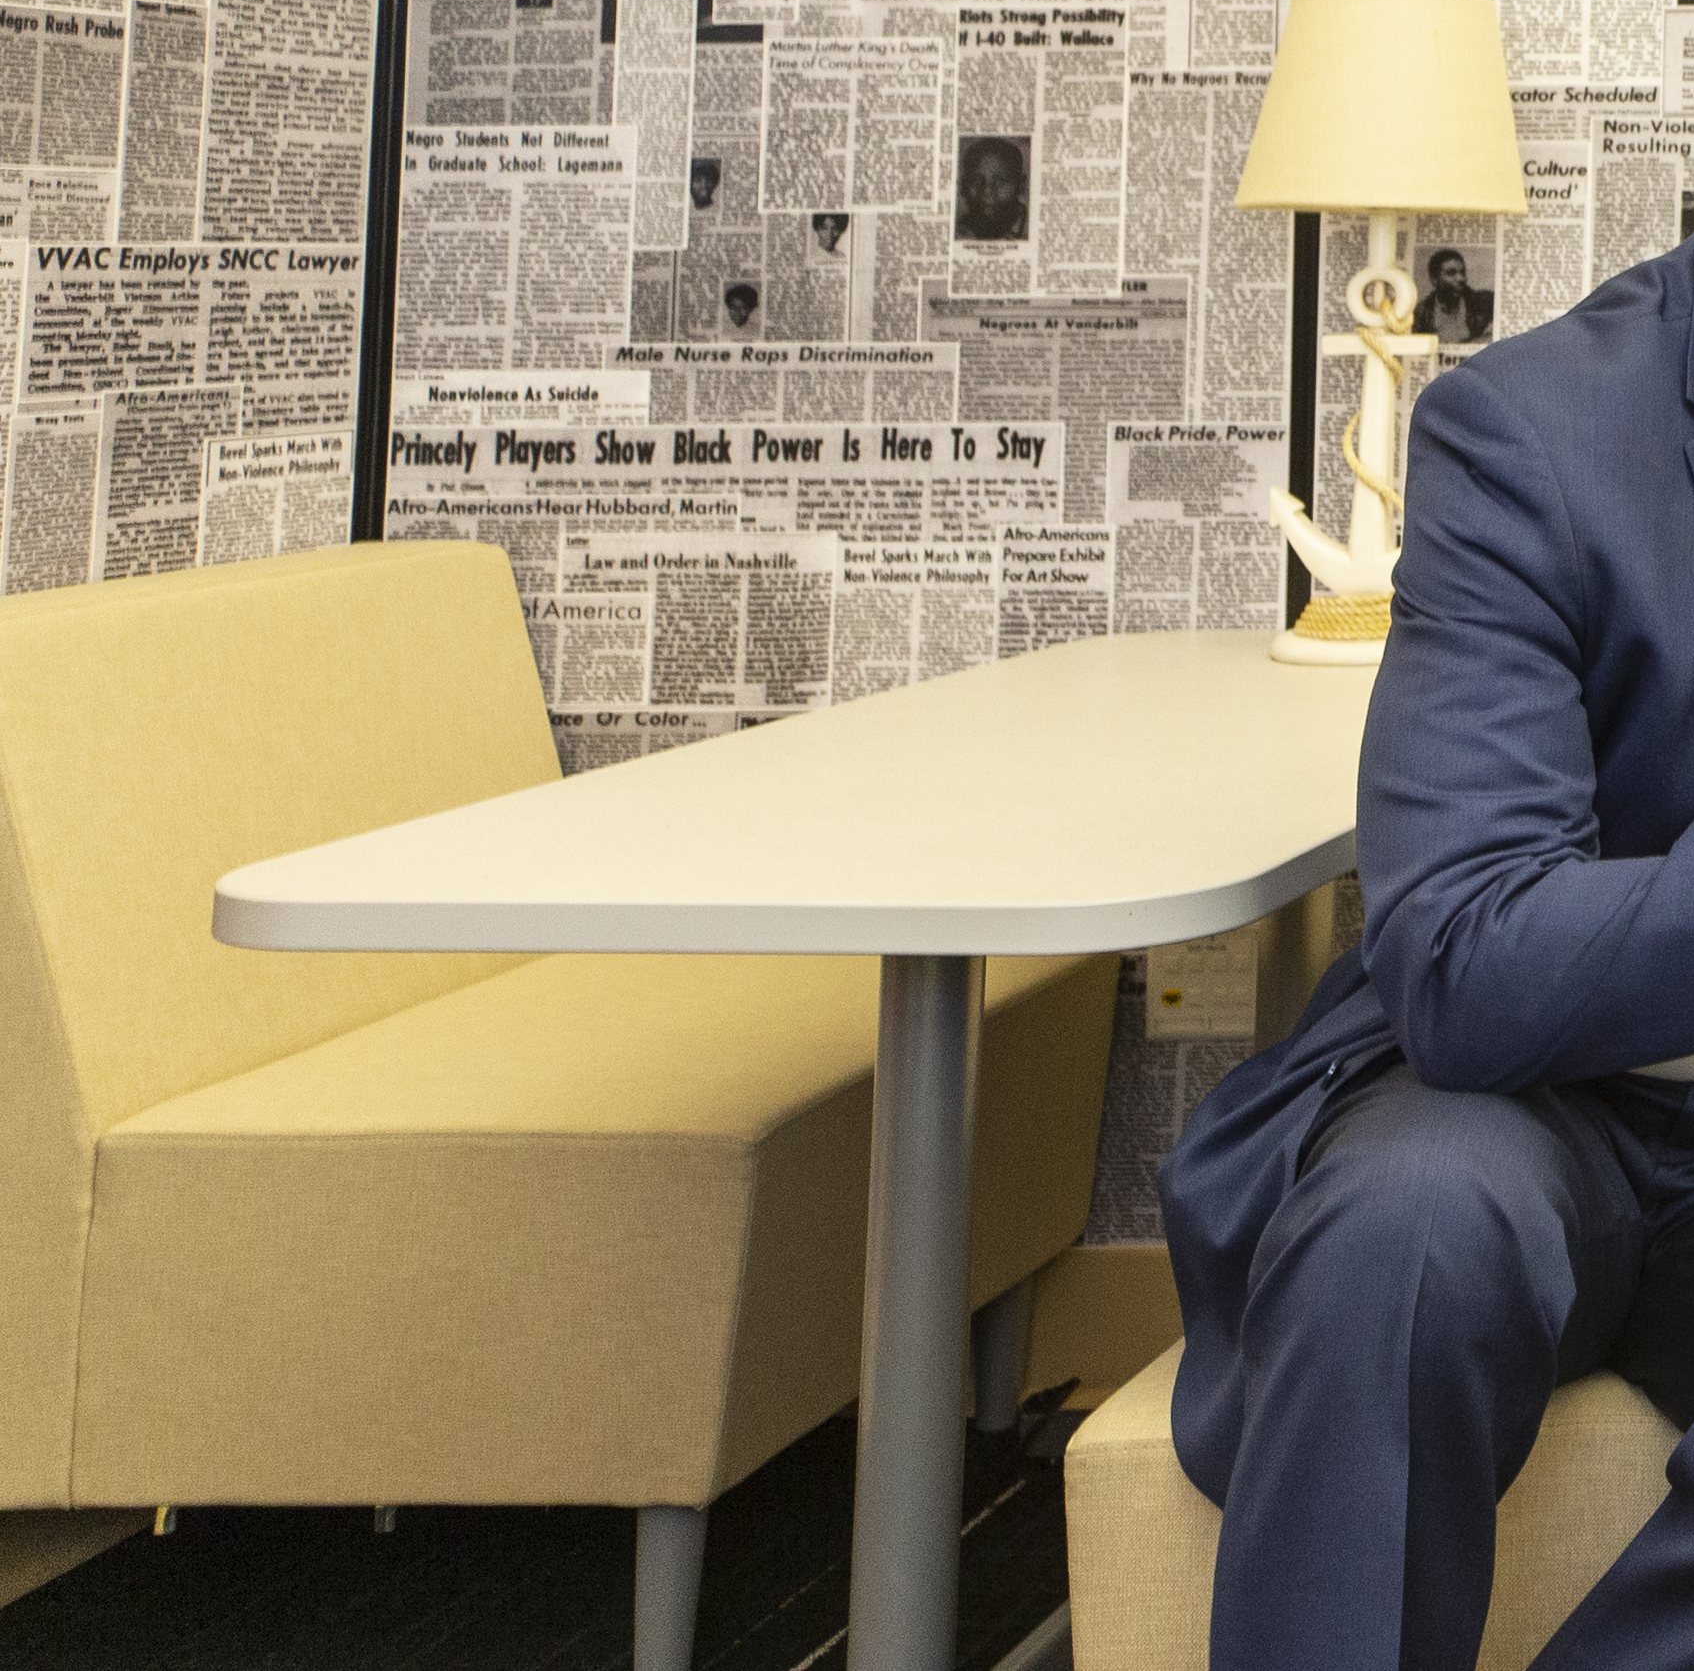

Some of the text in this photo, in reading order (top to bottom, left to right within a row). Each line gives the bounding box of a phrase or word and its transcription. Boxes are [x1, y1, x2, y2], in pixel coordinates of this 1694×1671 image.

[37, 247, 360, 274] VVAC Employs SNCC Lawyer
[615, 347, 934, 366] Male Nurse Raps Discrimination
[428, 386, 599, 402] Nonviolence As Suicide
[1114, 426, 1164, 443] Black
[1225, 425, 1286, 442] Power
[391, 427, 1045, 473] Princely Players Show Black Power Is Here To Stay
[387, 499, 536, 517] Afro-Americans
[585, 499, 676, 519] Hubbard,
[679, 499, 739, 517] Martin
